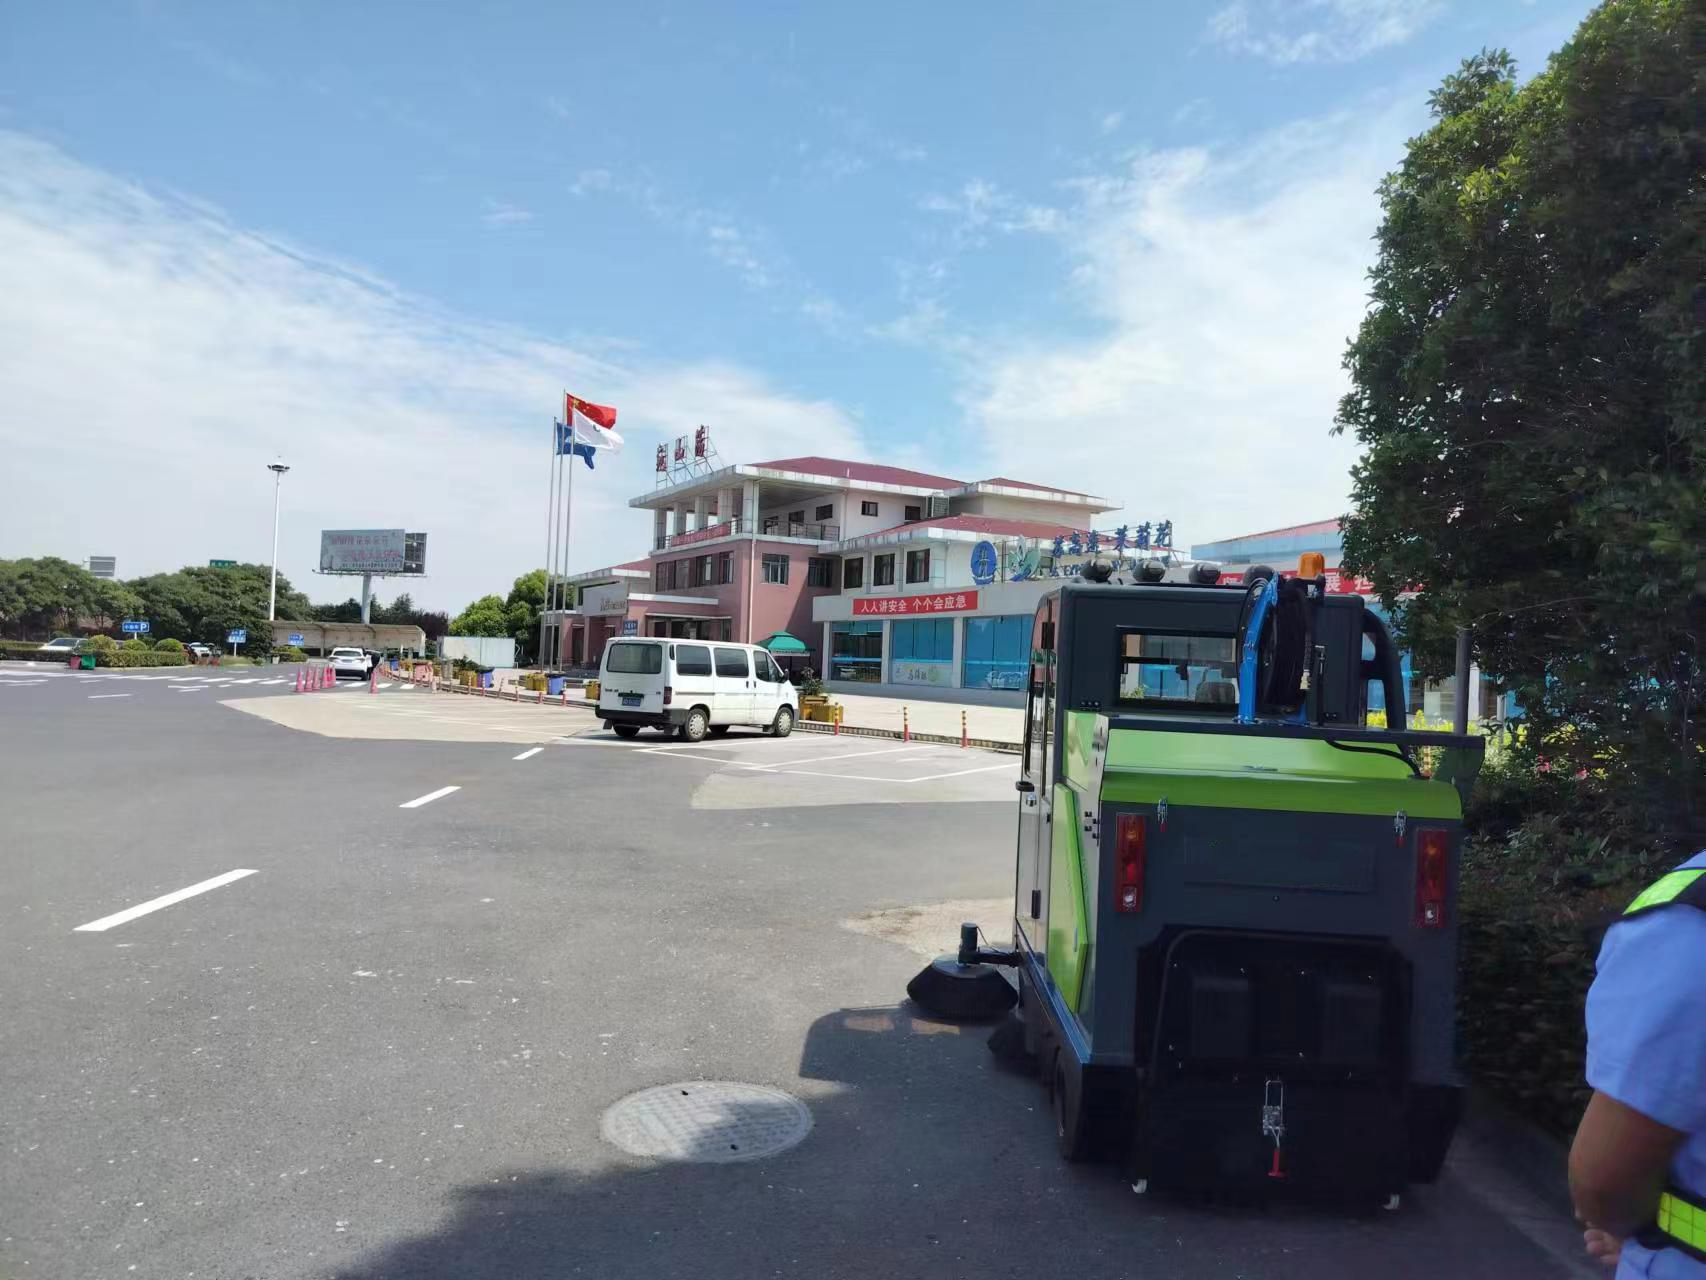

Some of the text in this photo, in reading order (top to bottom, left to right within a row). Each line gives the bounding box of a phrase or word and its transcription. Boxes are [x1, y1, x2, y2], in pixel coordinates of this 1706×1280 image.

[861, 595, 967, 613] 人人讲安全 个个会应急
